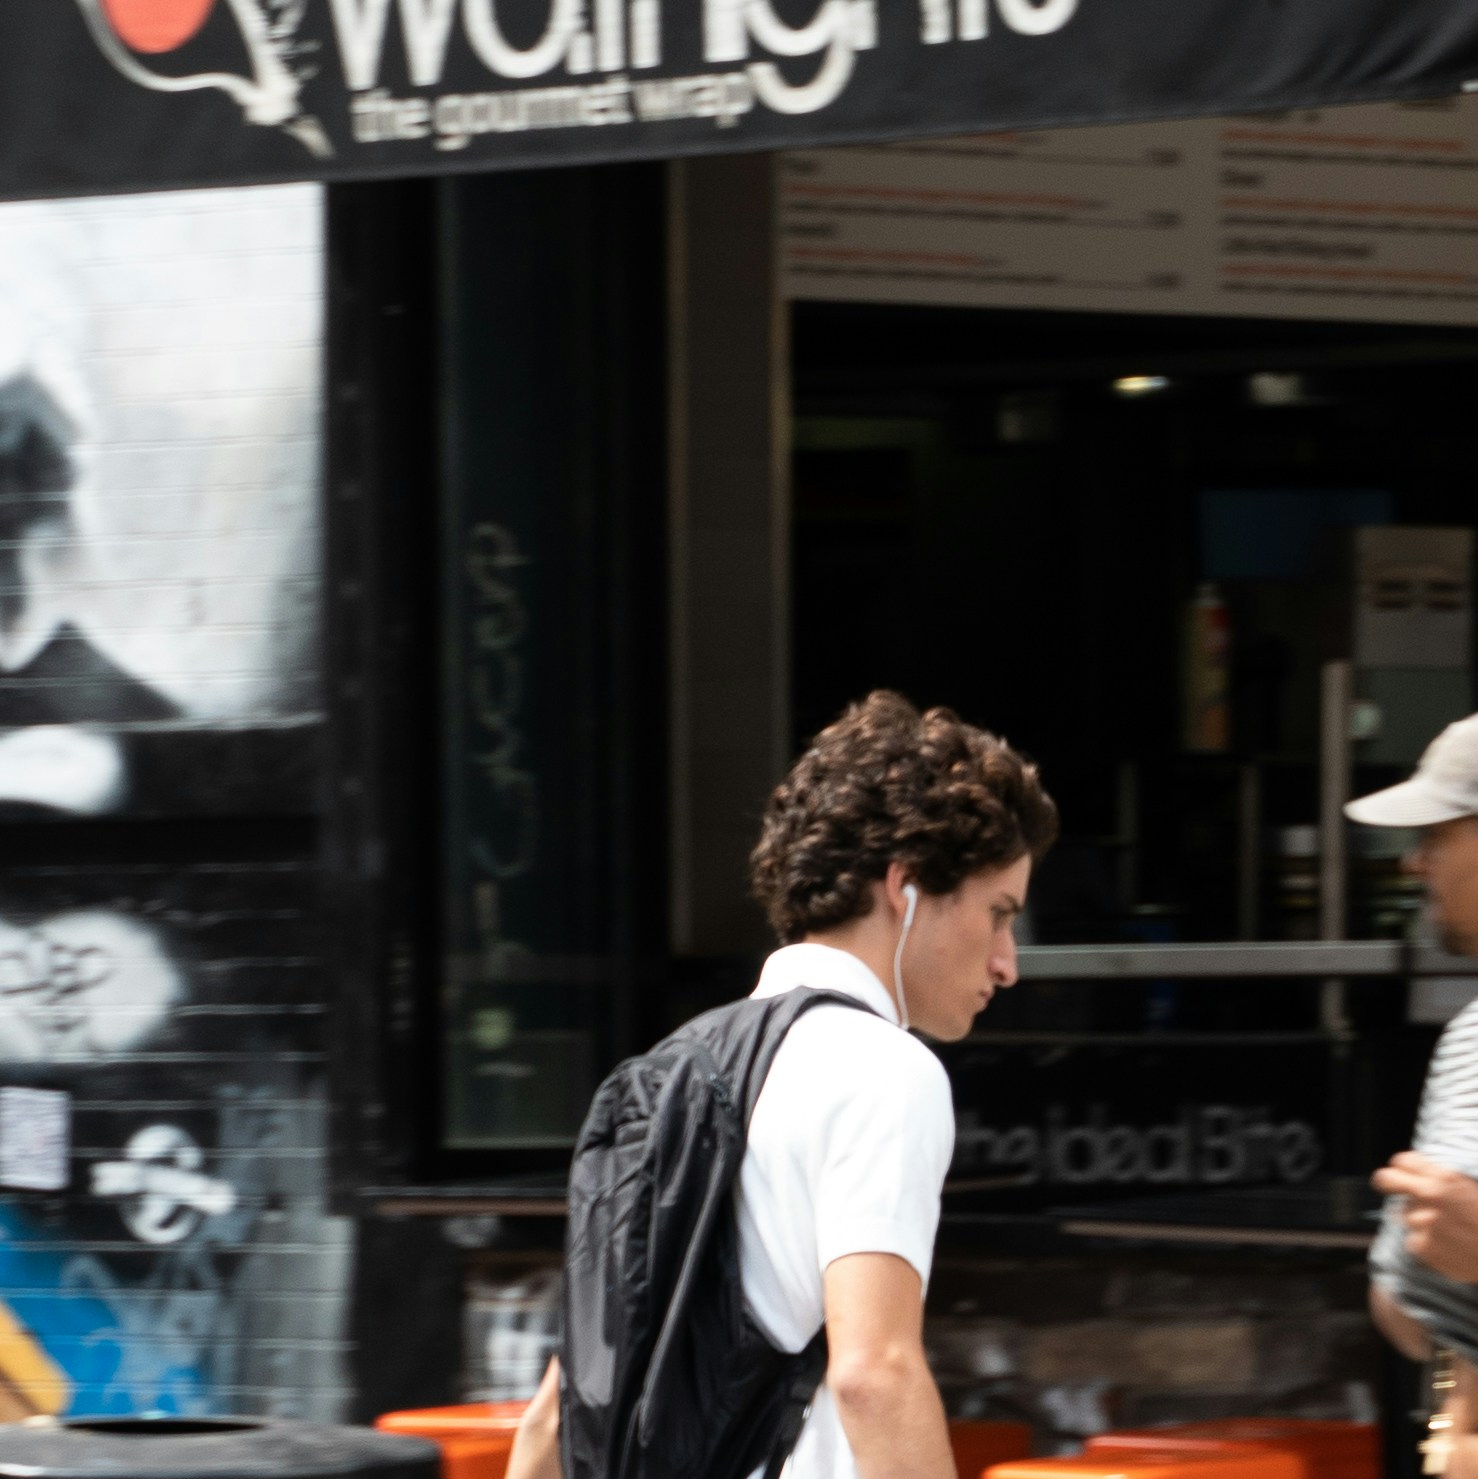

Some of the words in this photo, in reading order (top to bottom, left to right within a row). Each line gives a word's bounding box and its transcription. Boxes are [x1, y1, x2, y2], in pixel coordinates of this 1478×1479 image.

[350, 86, 431, 143] the
[433, 75, 632, 150] gourmet
[633, 71, 755, 129] wrap
